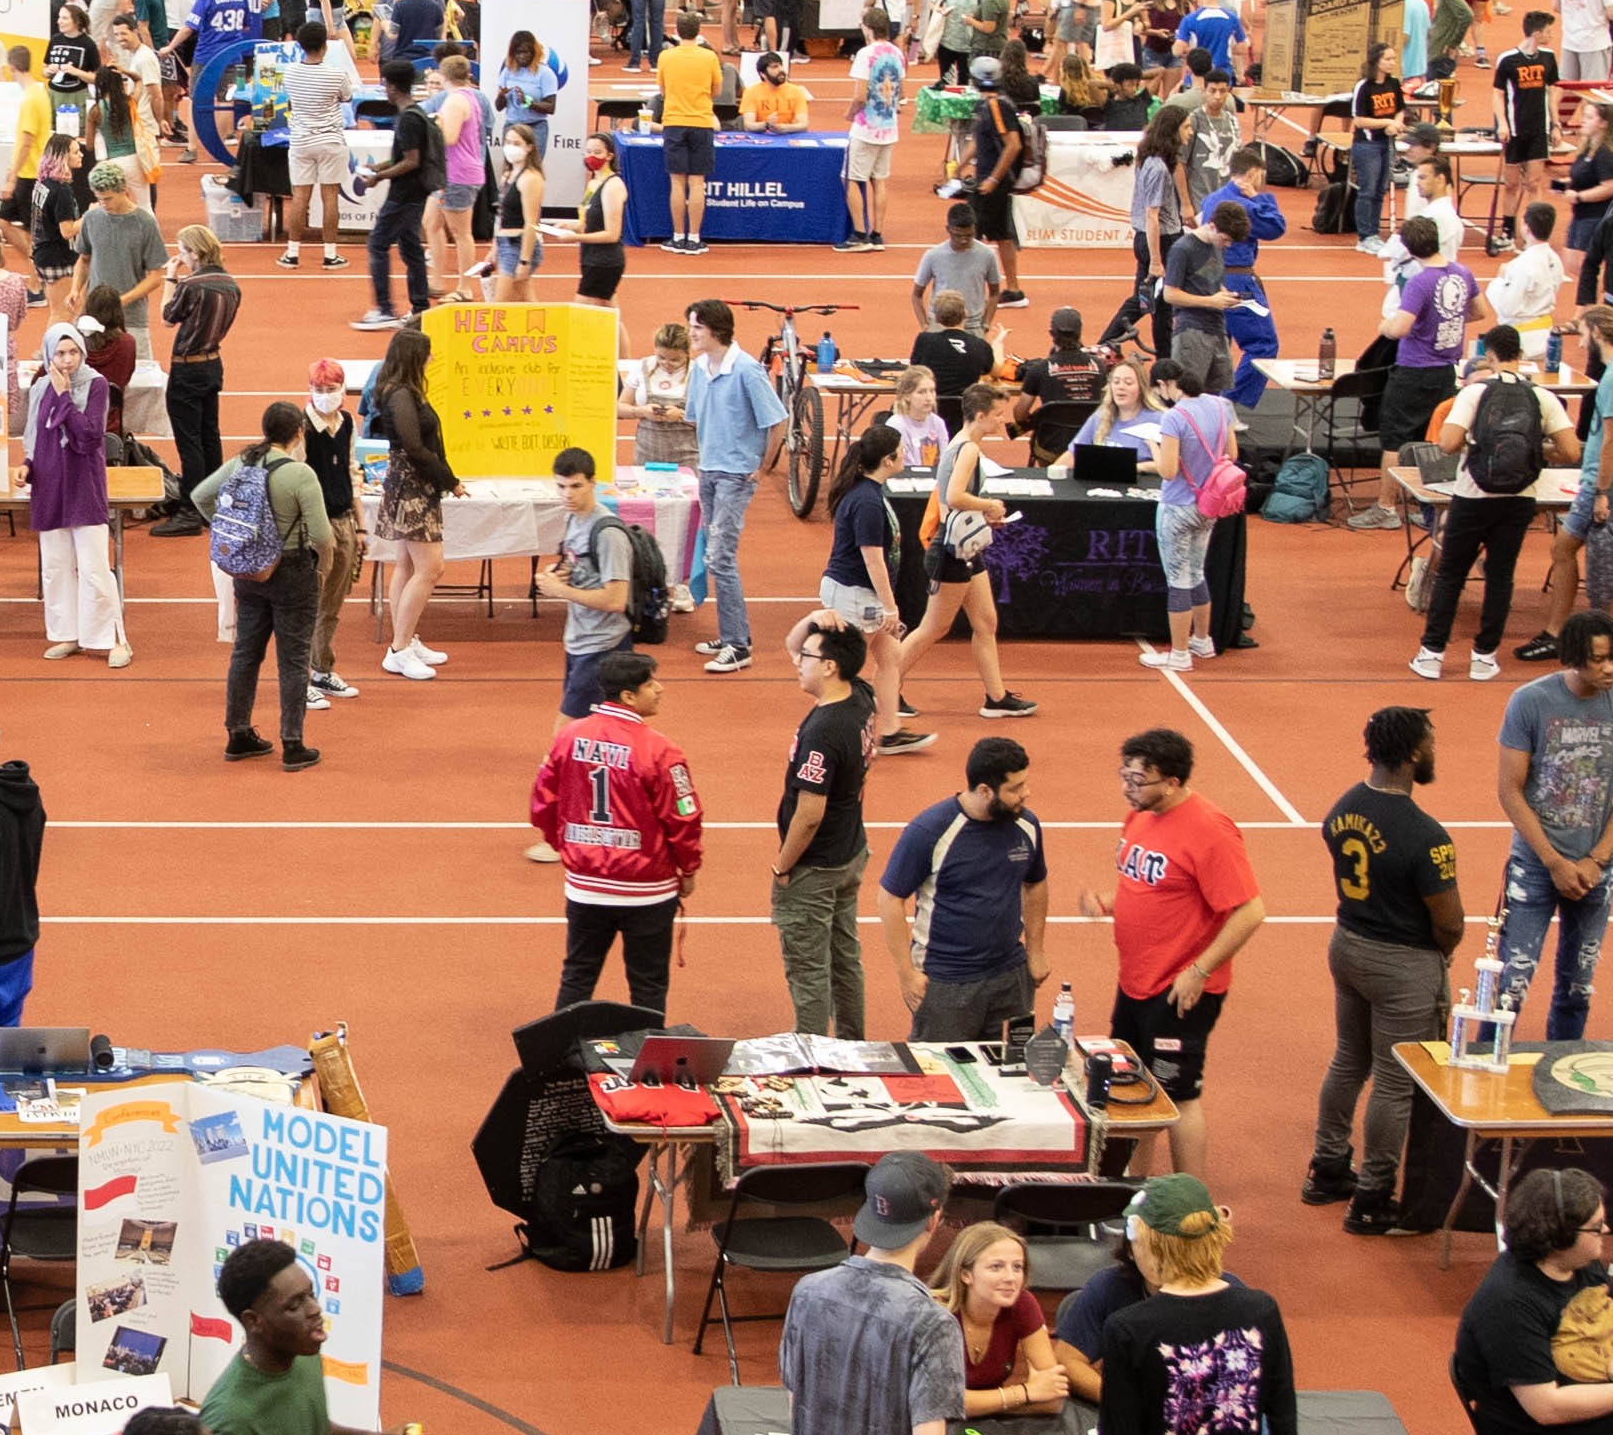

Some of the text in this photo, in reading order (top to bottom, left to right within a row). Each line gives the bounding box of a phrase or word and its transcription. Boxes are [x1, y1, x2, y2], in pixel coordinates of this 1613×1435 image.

[210, 9, 246, 32] 438
[1517, 65, 1545, 80] RIT
[1371, 93, 1395, 109] RIT
[554, 134, 582, 149] FIRE
[726, 182, 787, 197] HILLEL
[705, 198, 805, 210] Student Life on Campus
[1059, 227, 1122, 244] STUDENT
[454, 309, 508, 334] HER
[471, 335, 557, 354] CAMPUS
[454, 362, 469, 375] An
[1087, 529, 1156, 560] RIT
[1561, 726, 1600, 744] MARVEL
[572, 737, 631, 768] NAVI
[809, 751, 825, 767] B
[797, 765, 827, 784] AZ
[589, 766, 612, 825] 1
[1340, 838, 1370, 901] 3
[263, 1107, 381, 1168] MODEL
[252, 1143, 384, 1206] UNITED
[229, 1174, 380, 1243] NATIONS
[55, 1394, 140, 1420] MONACO
